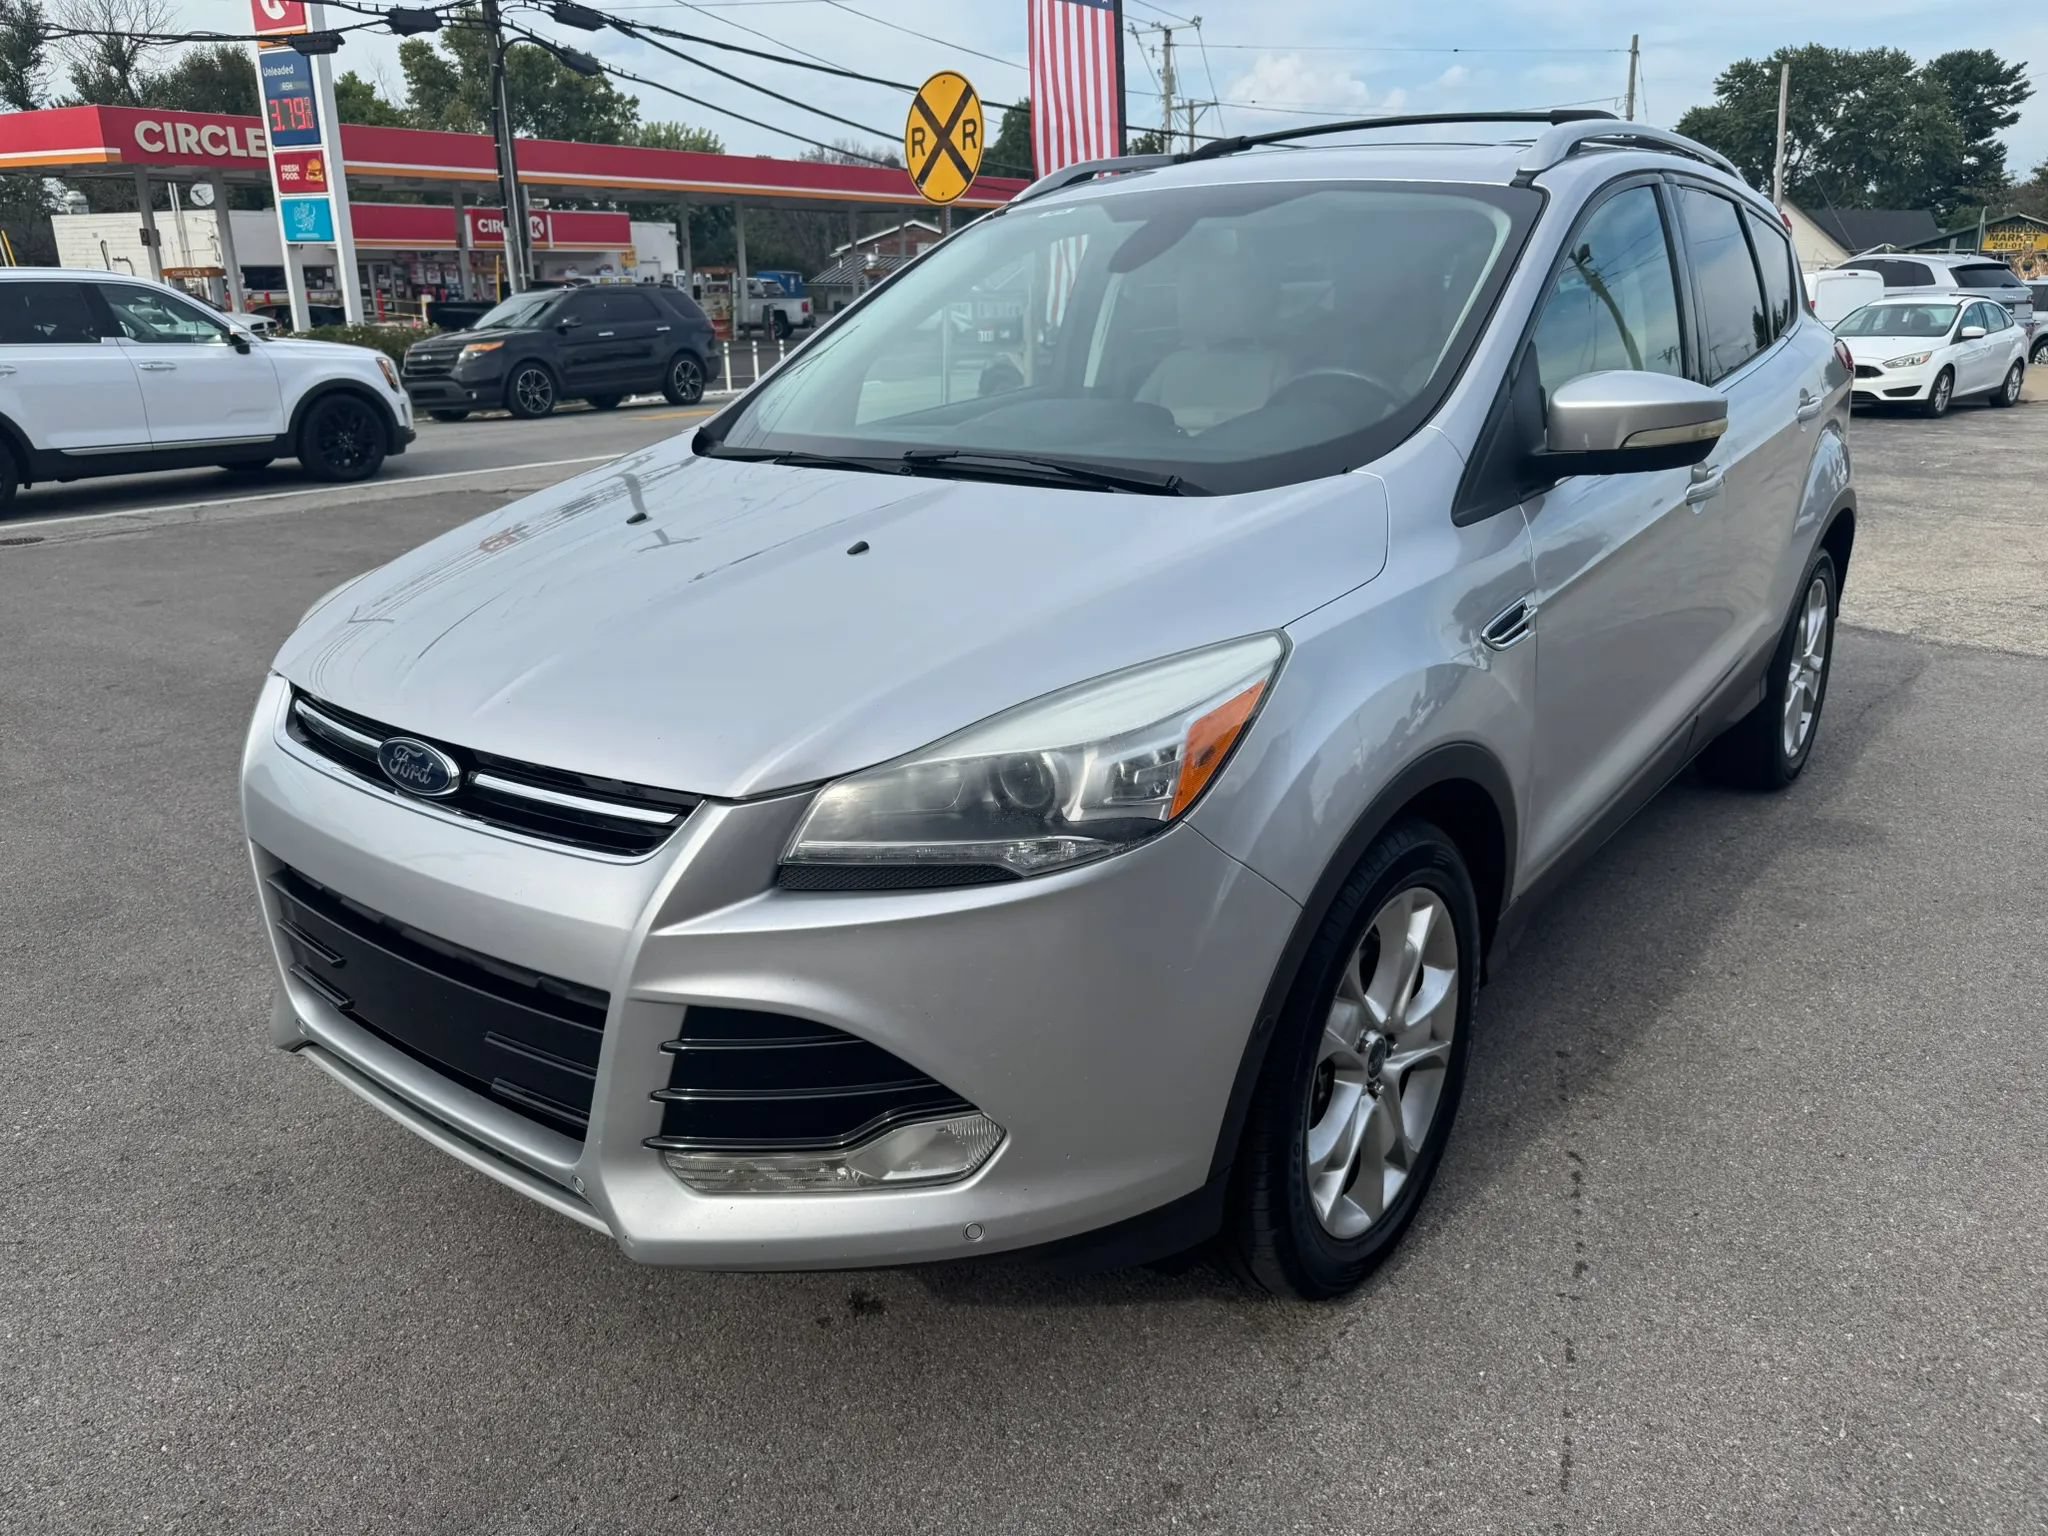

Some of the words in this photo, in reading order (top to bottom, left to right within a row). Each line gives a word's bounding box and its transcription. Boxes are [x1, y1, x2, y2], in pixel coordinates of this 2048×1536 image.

[262, 64, 294, 77] Unleaded
[134, 120, 268, 158] CIRCLE
[911, 127, 926, 158] R
[962, 119, 977, 150] R
[281, 164, 300, 173] FRESH
[530, 218, 545, 238] K
[1989, 233, 2041, 242] MARKET
[389, 744, 434, 784] Ford
